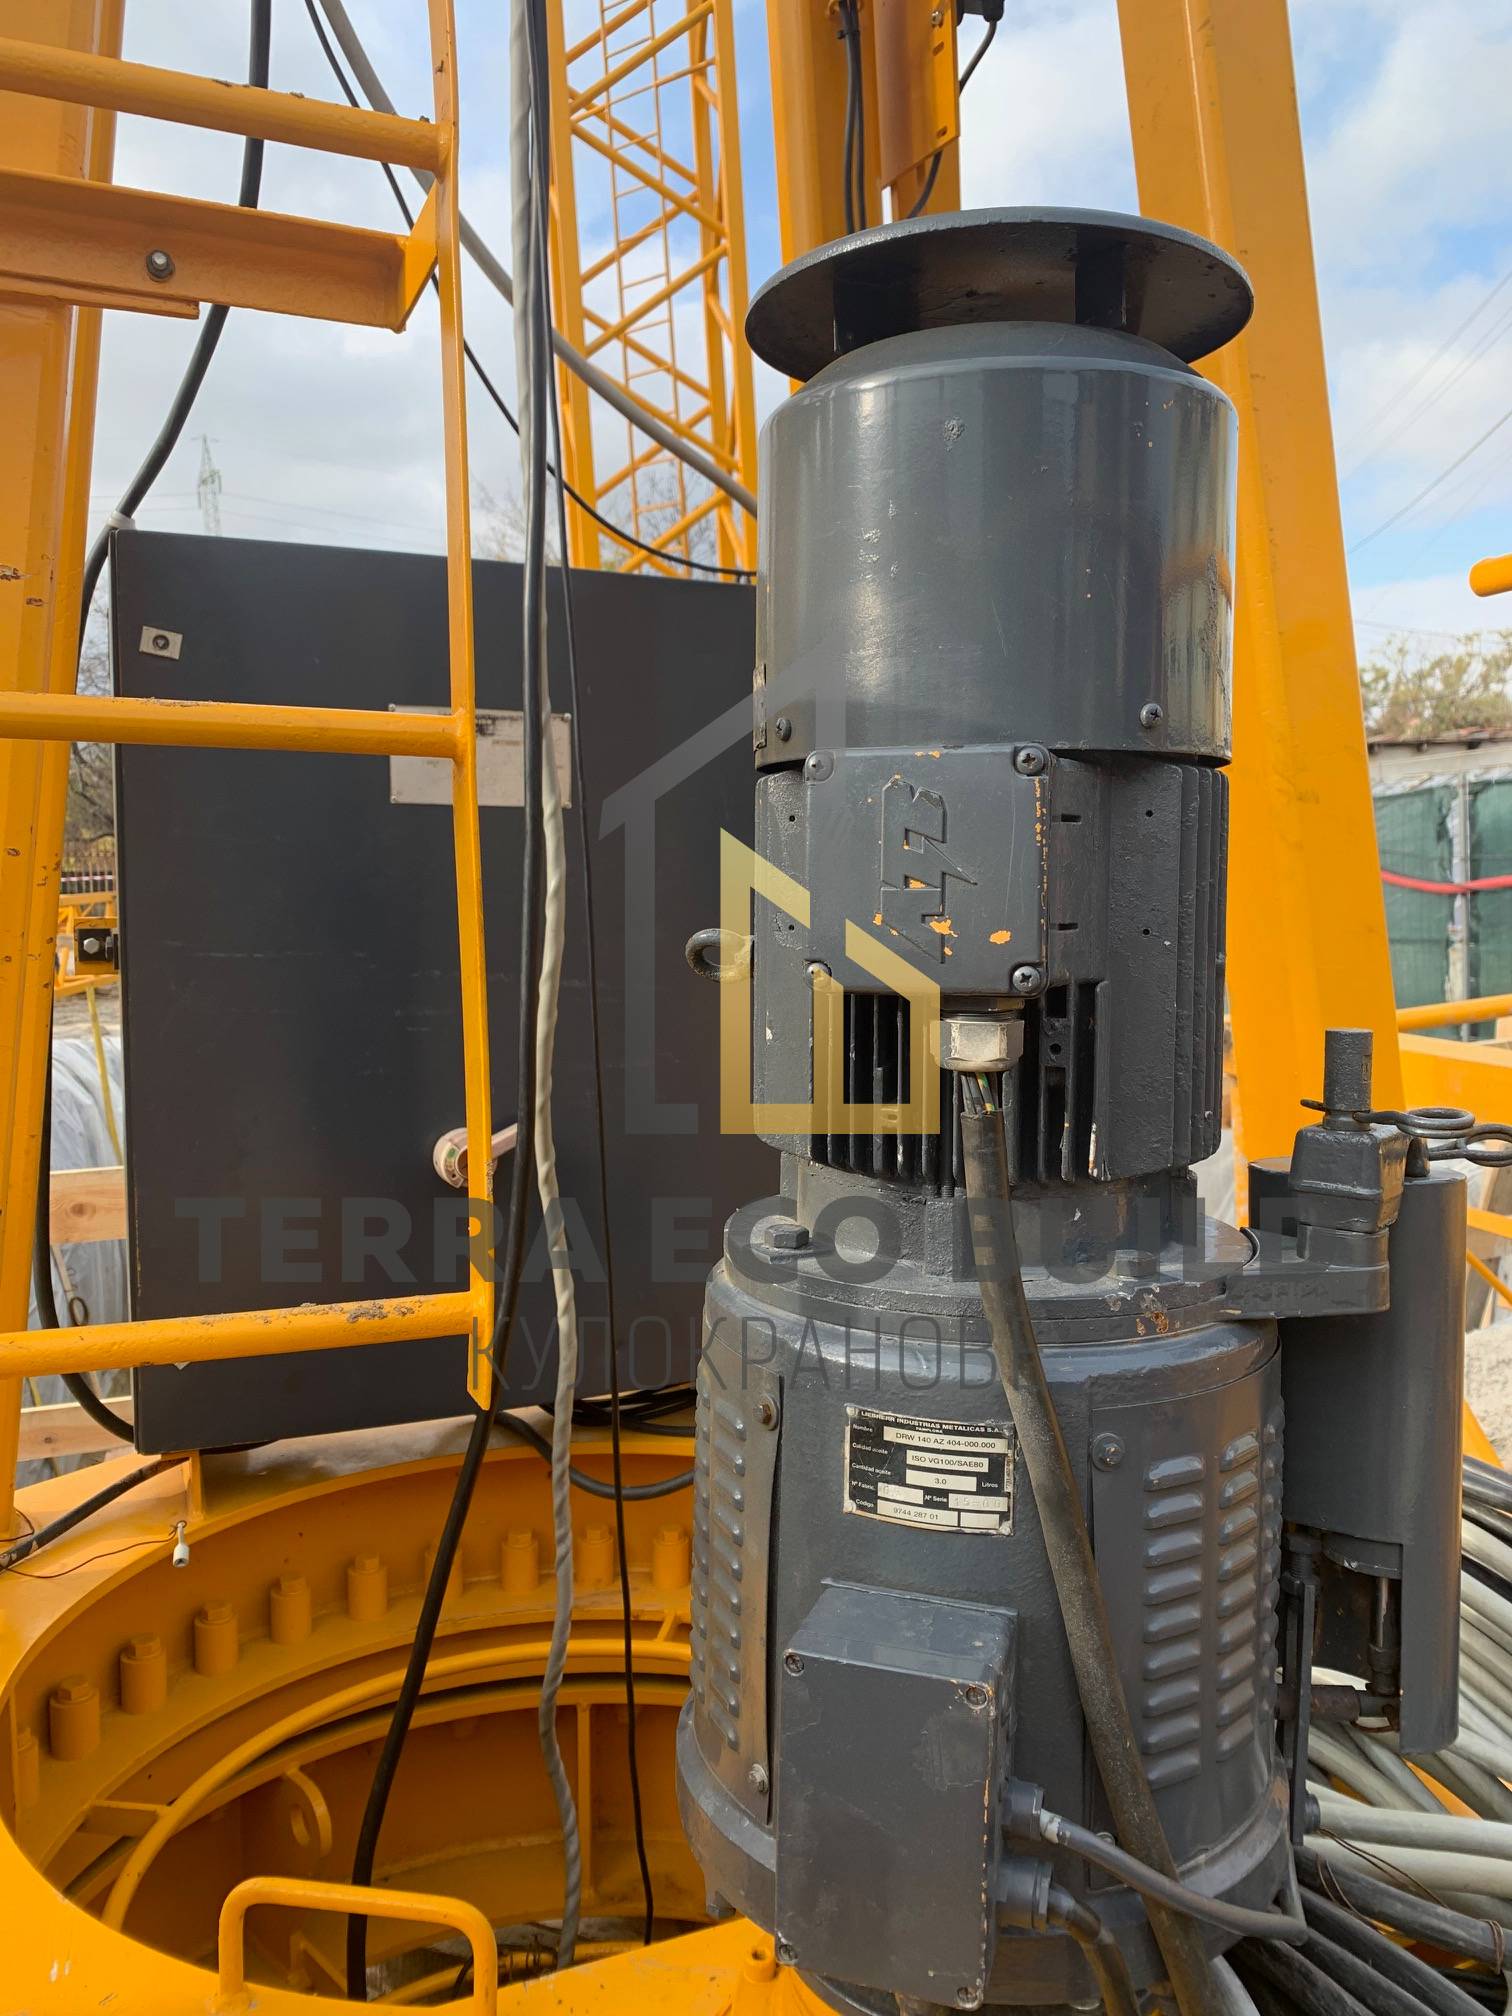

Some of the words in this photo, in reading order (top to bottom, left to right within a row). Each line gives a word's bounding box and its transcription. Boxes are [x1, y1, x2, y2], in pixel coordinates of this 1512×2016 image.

[896, 1418, 940, 1429] INDUSTRIAS
[942, 1424, 985, 1432] METALICAS
[896, 1432, 915, 1440] DRW
[946, 1440, 996, 1449] 404-000.000
[928, 1456, 984, 1468] VG100/SAE80
